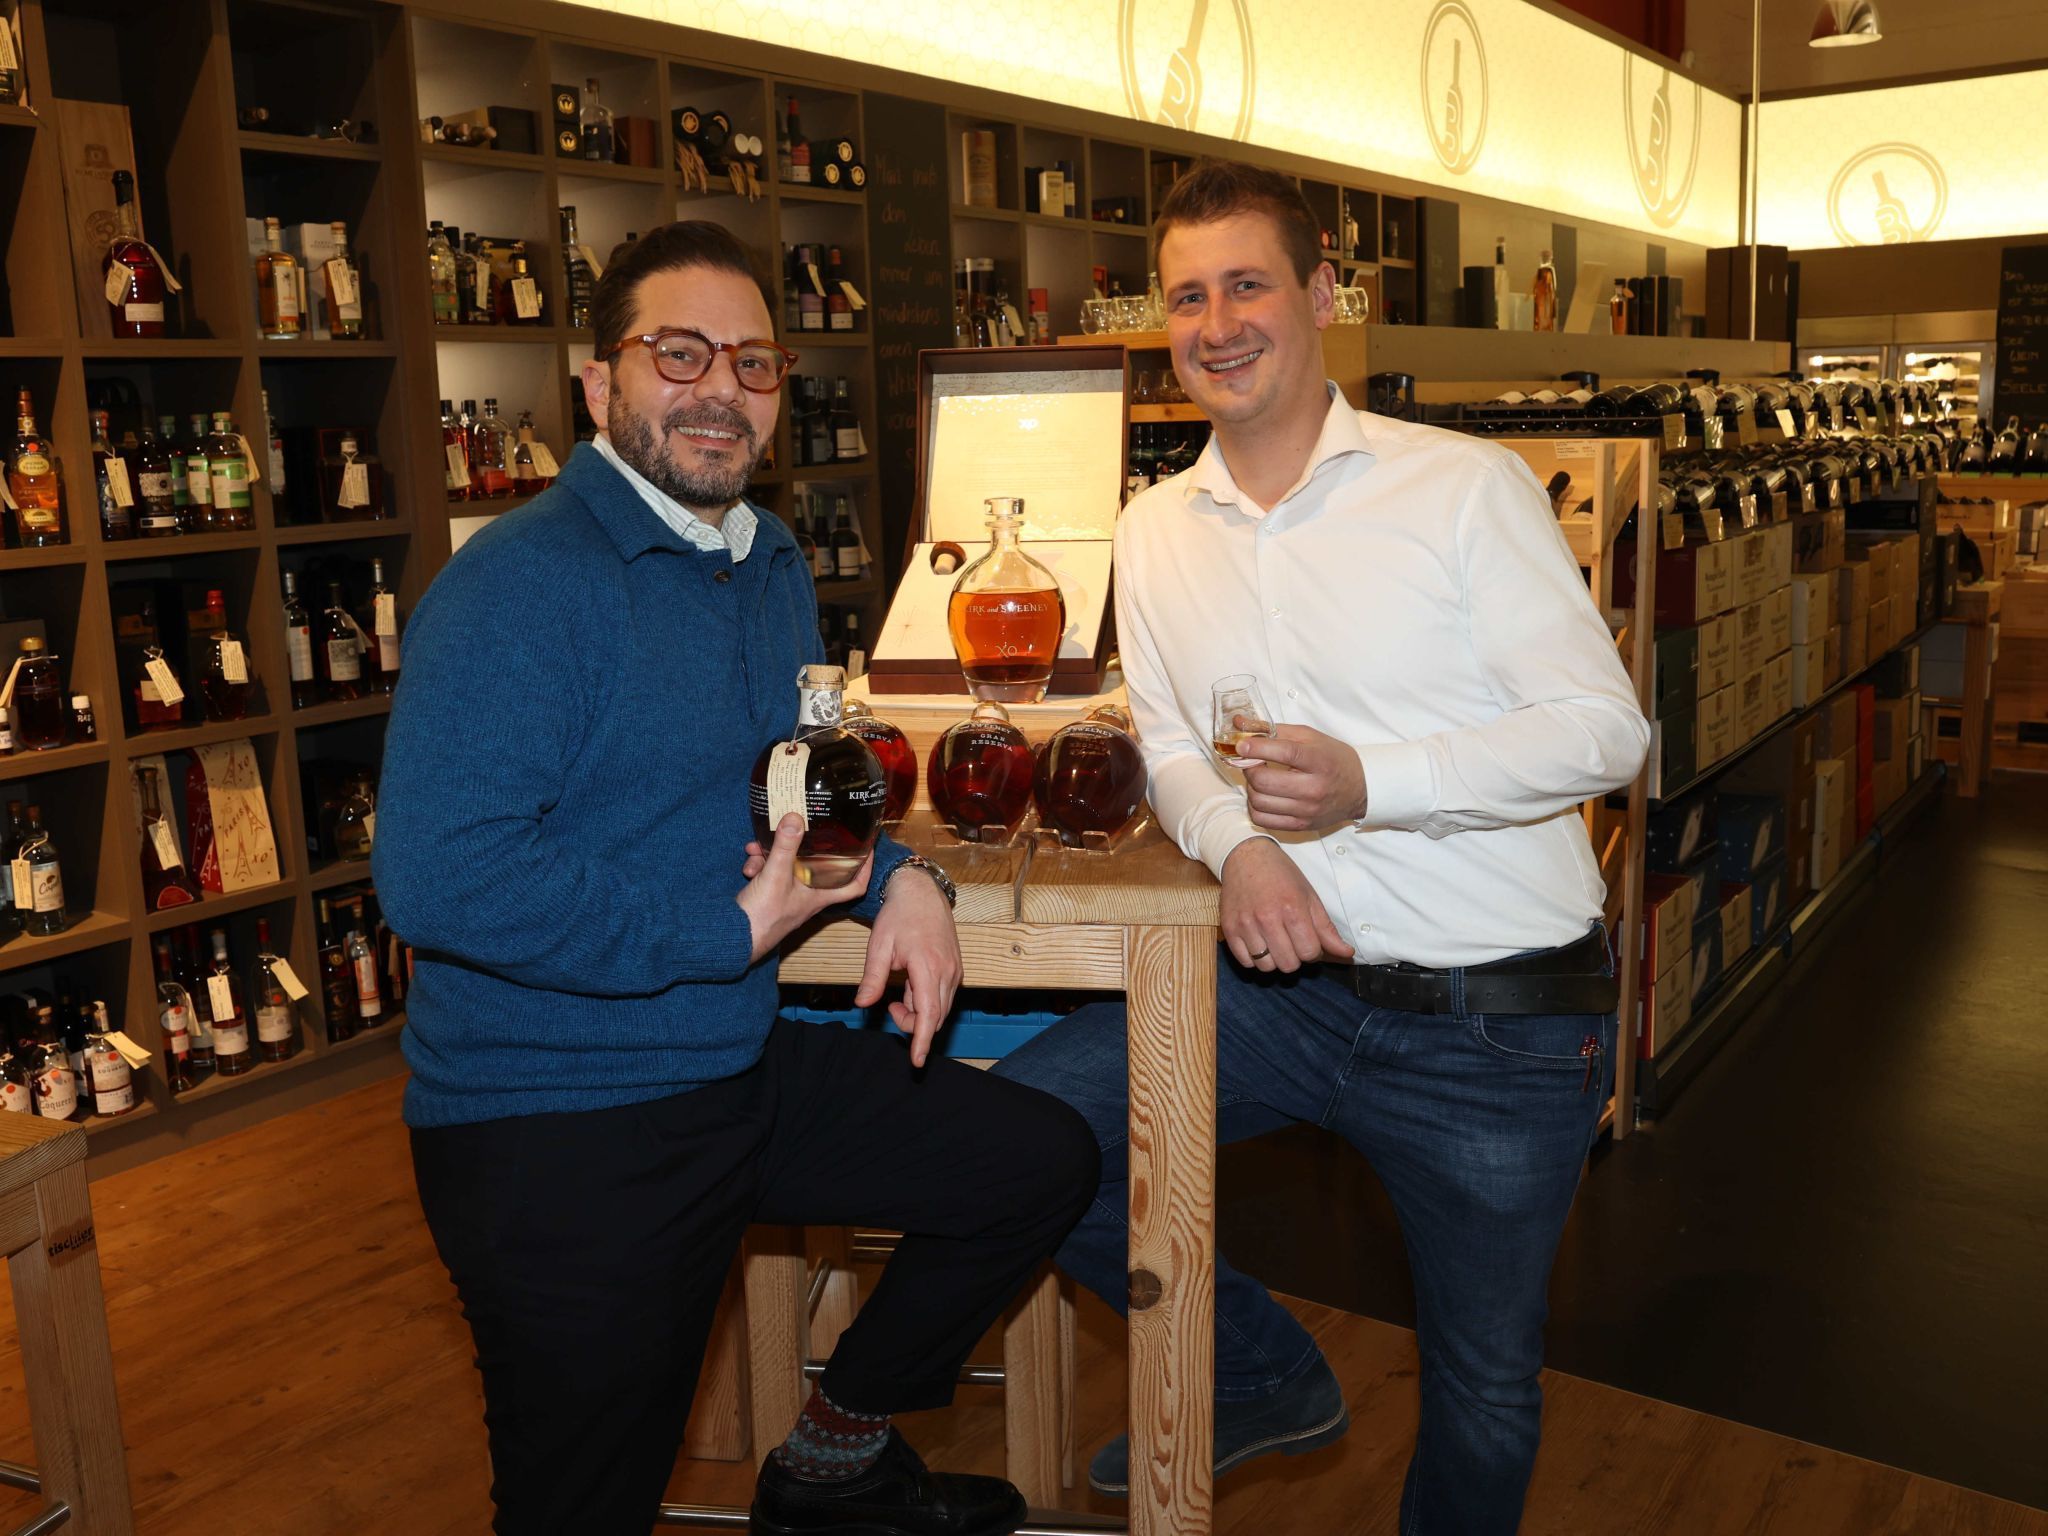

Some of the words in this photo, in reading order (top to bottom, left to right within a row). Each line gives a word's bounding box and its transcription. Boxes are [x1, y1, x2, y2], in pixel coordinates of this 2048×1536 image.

[1000, 603, 1048, 613] SWEENEY
[995, 646, 1018, 657] XO
[858, 732, 892, 744] ESERVA
[971, 739, 1013, 752] RESERVA
[849, 791, 870, 801] KIRK
[223, 808, 244, 839] PARIS
